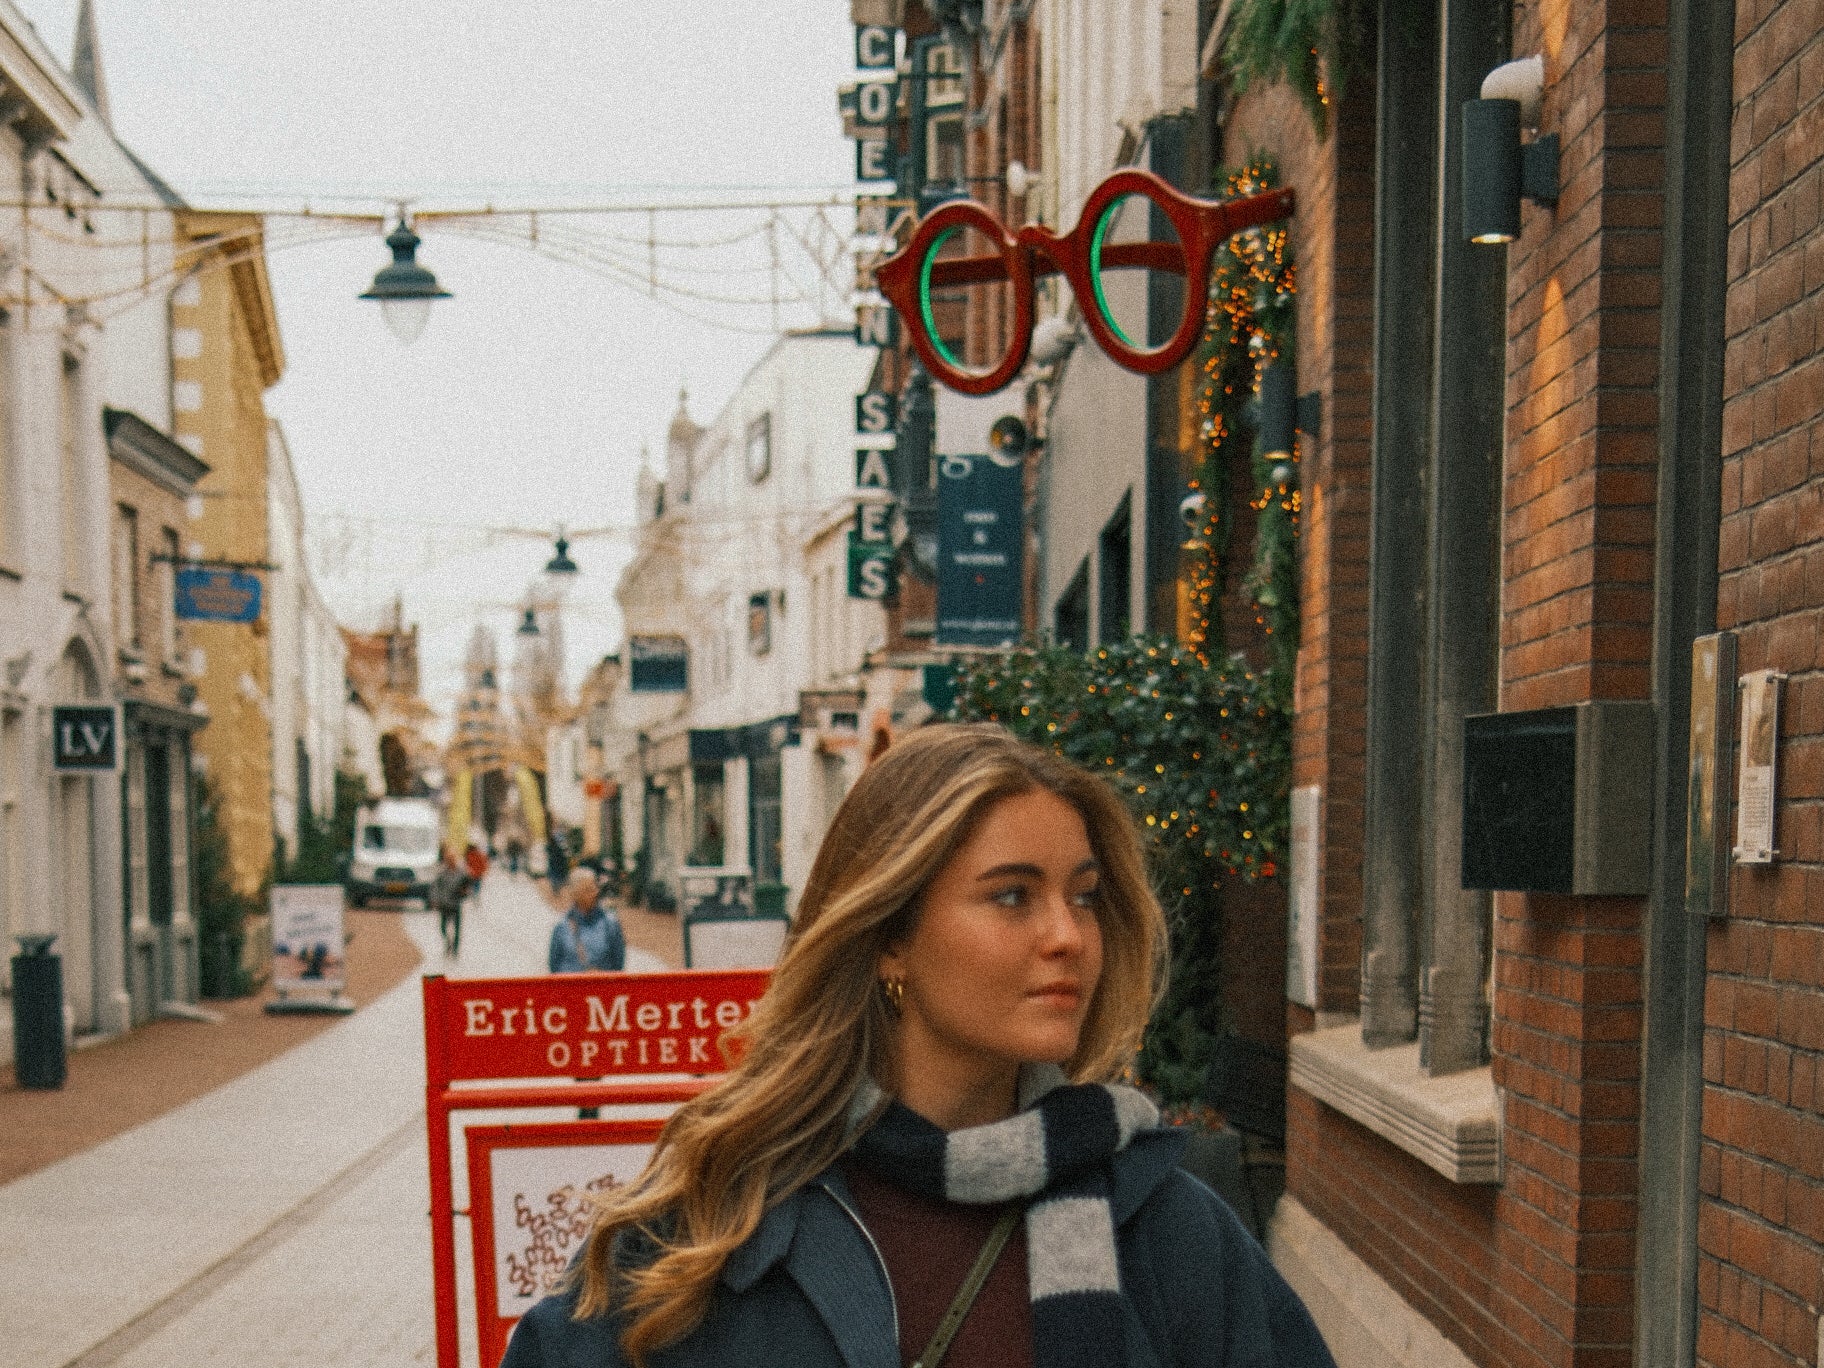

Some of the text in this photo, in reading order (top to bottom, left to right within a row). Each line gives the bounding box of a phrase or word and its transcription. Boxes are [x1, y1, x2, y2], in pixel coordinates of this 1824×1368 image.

[860, 394, 889, 598] SAES
[61, 721, 109, 755] LV
[464, 994, 759, 1036] Eric Merte
[547, 1036, 710, 1068] OPTIEK
